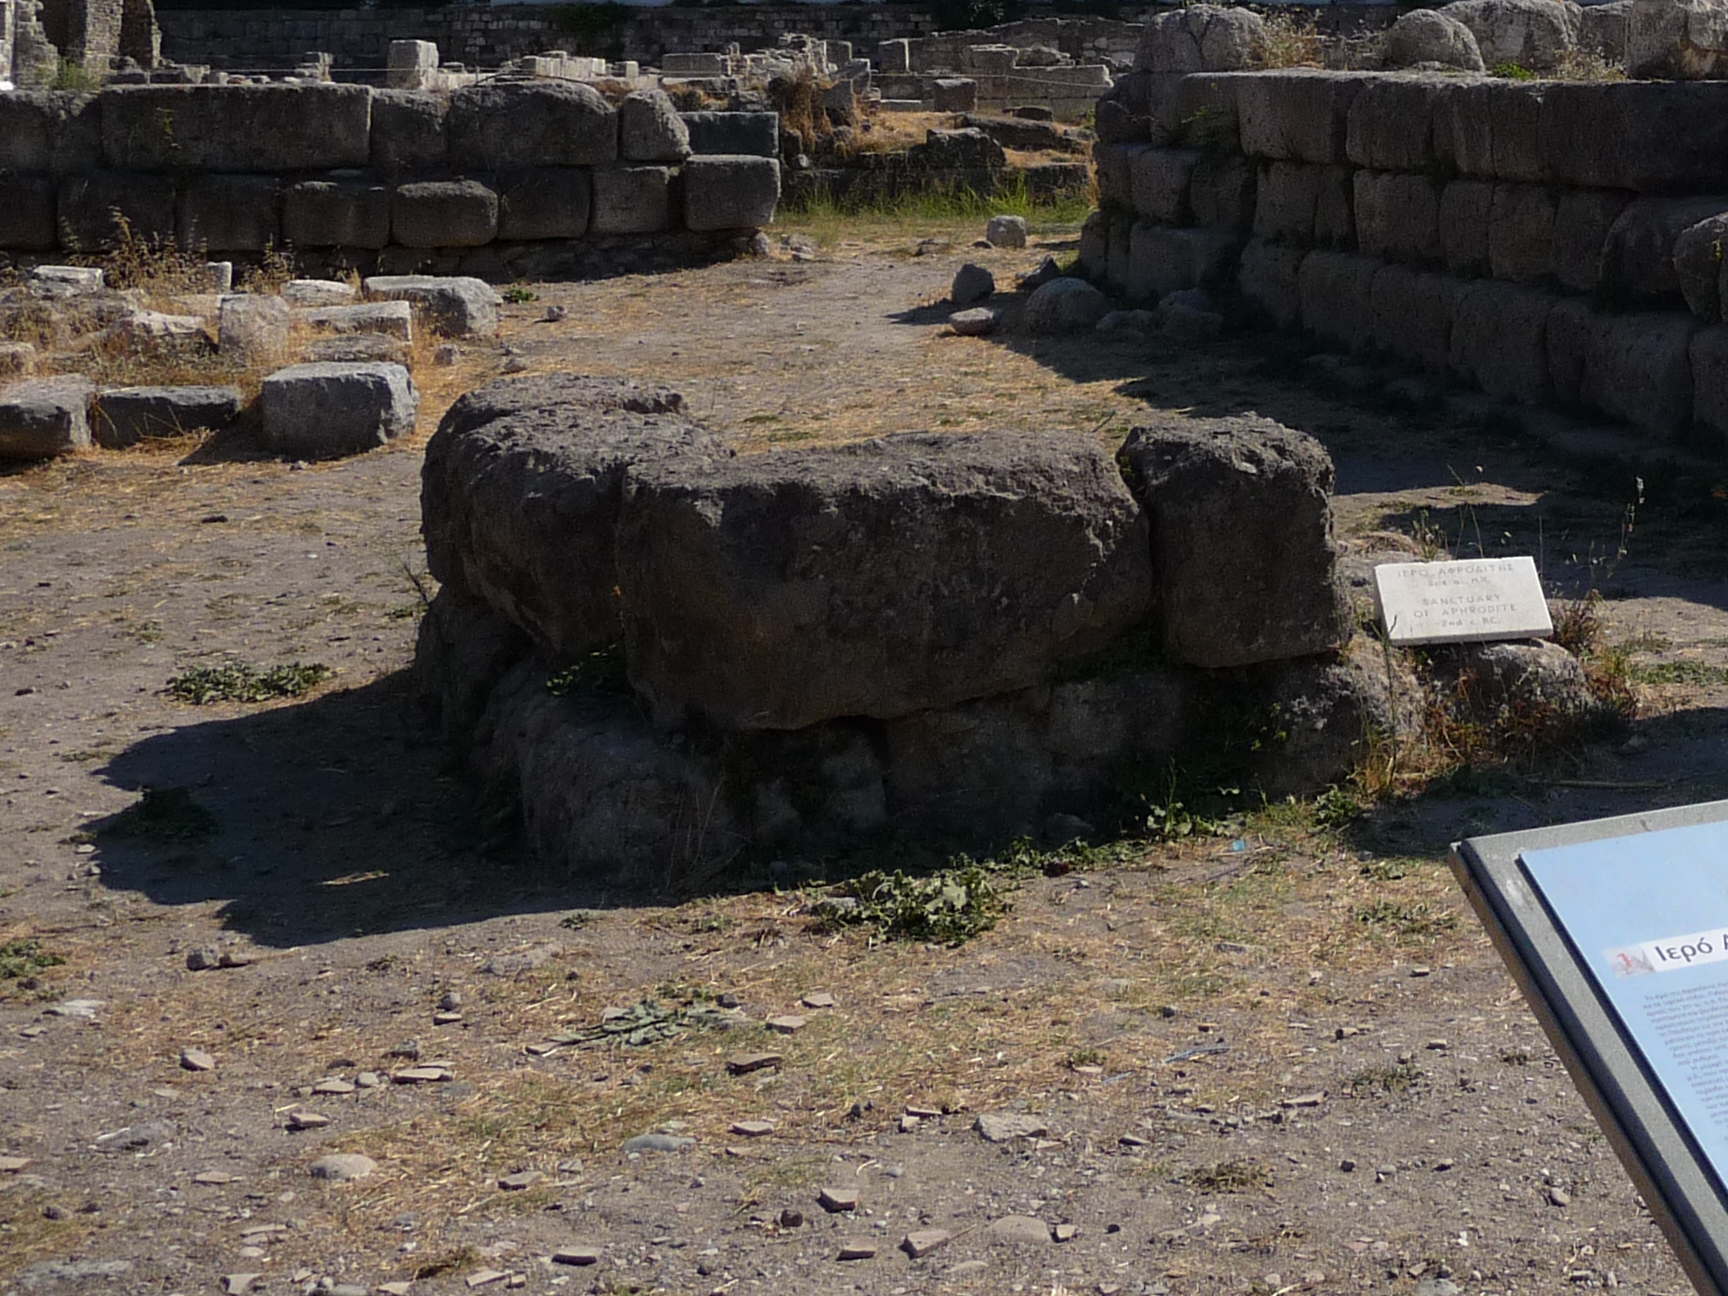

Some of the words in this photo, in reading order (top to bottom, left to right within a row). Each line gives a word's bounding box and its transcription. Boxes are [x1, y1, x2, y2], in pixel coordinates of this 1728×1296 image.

[1438, 563, 1514, 576] ΑΦΡΟΔΙΤΗΣ
[1421, 593, 1500, 606] SANCTUARY
[1441, 603, 1518, 616] APHRODITE
[1654, 937, 1713, 962] Ιερό
